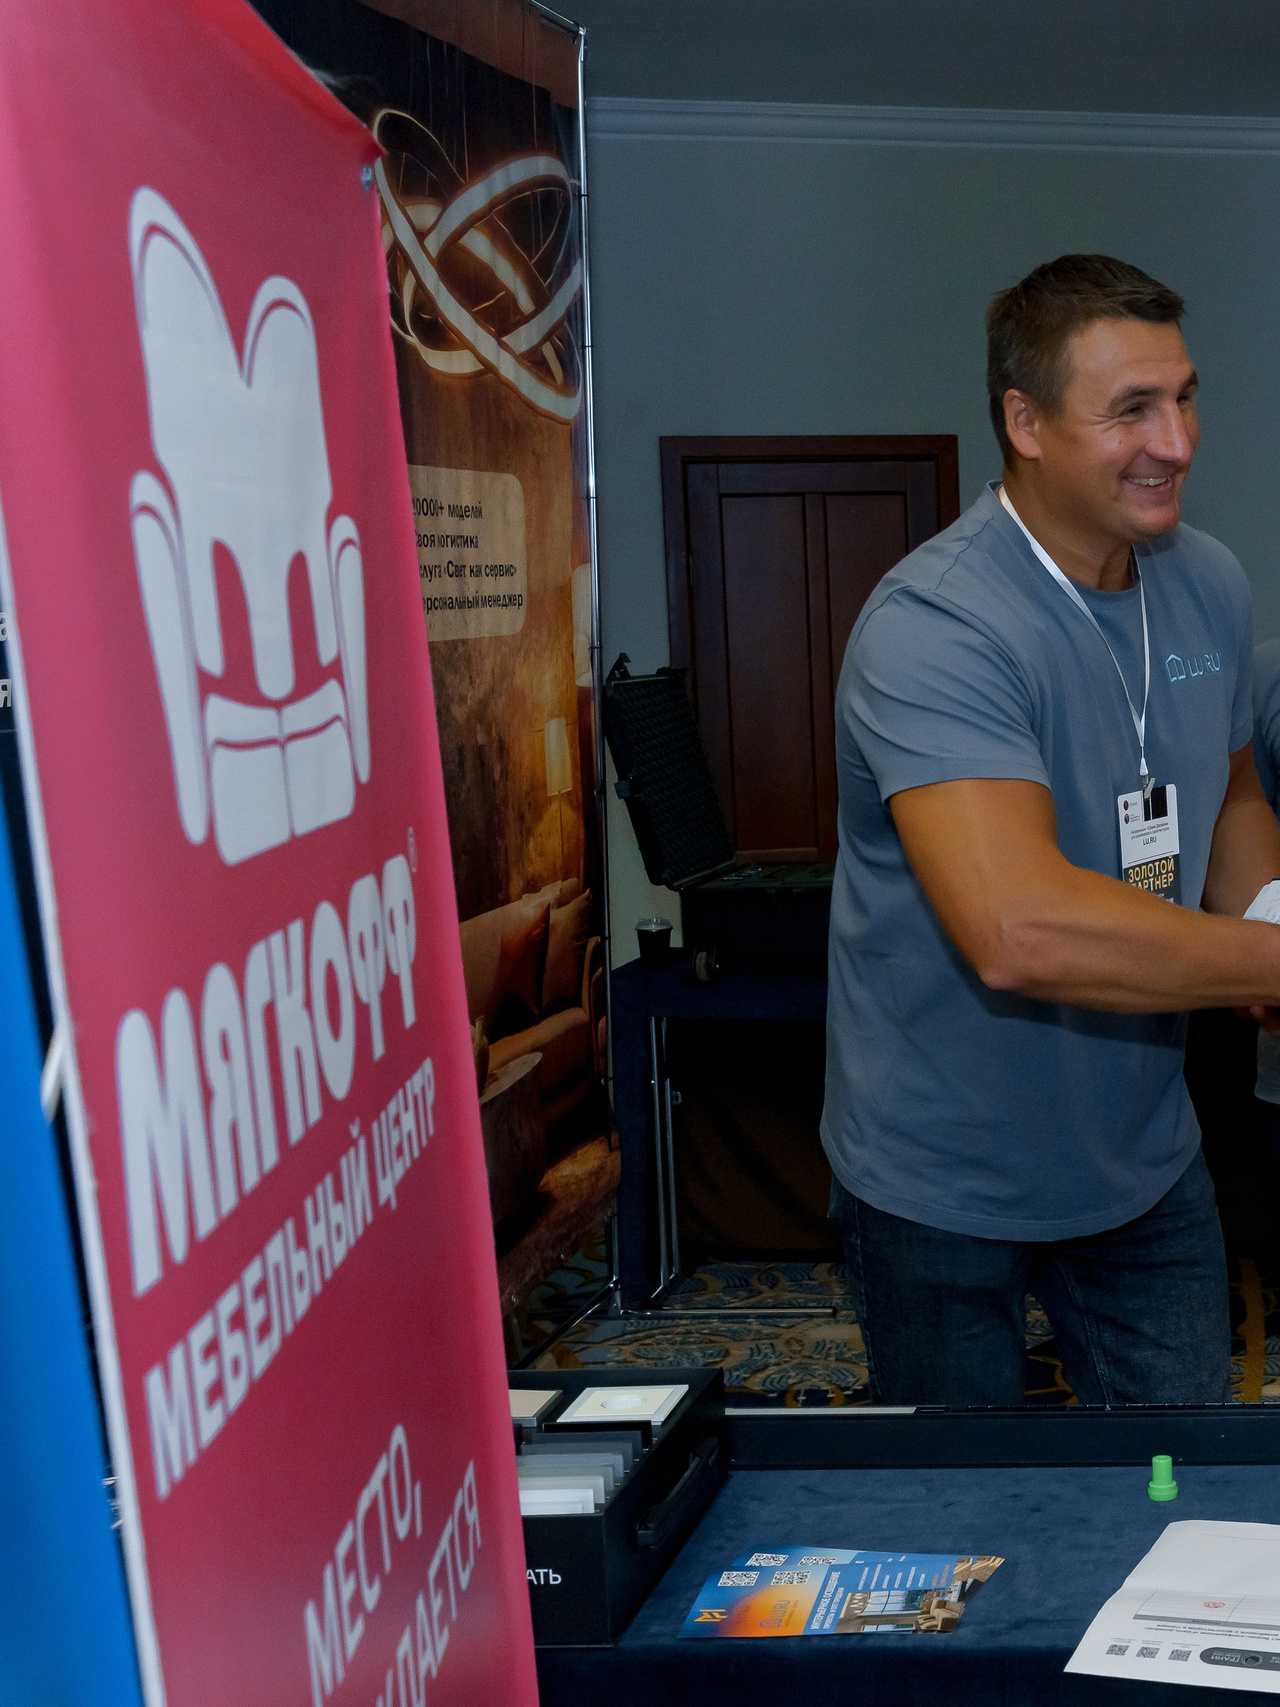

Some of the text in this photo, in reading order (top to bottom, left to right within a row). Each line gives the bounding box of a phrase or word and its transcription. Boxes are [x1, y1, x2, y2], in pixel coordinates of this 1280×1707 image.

[448, 501, 483, 520] моделей
[415, 533, 479, 549] воя логистика
[419, 564, 442, 582] слуга
[469, 564, 483, 578] как
[484, 563, 517, 581] сервис»
[422, 591, 523, 615] ерсональный менеджер
[1128, 855, 1175, 882] ЗОЛОТОЙ
[1130, 873, 1174, 891] АРТНЕР
[116, 854, 417, 1297] МЯГКОФФ
[143, 1057, 435, 1502] МЕБЕЛЬНЫЙ ЦЕНТР
[304, 1423, 423, 1707] МЕСТО,
[526, 1568, 562, 1586] АТЬ
